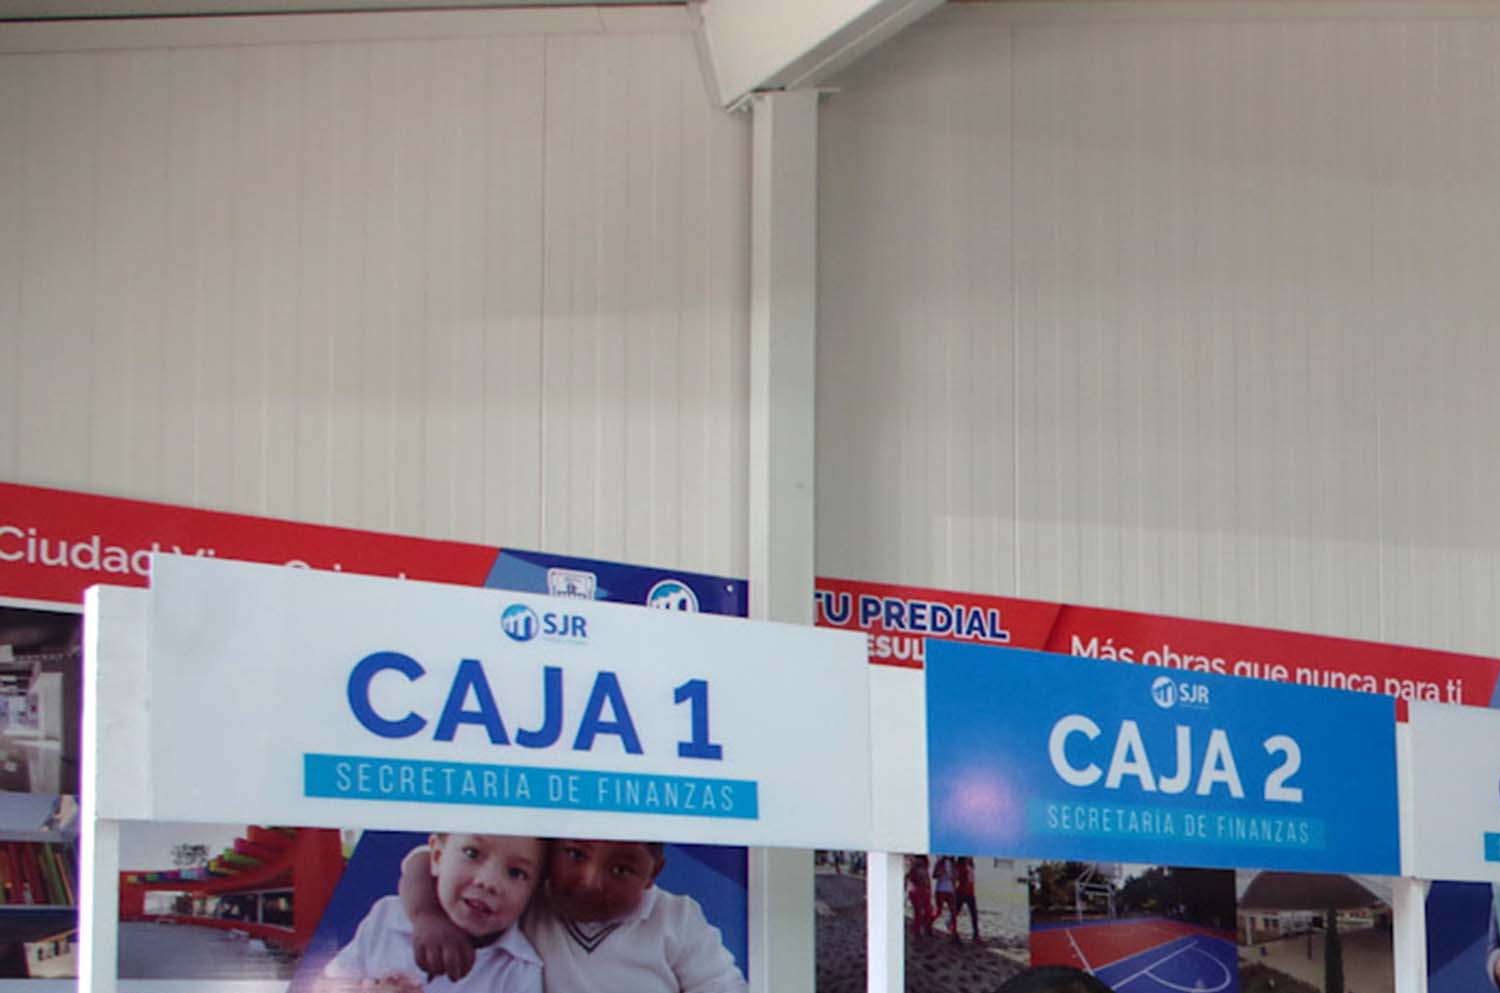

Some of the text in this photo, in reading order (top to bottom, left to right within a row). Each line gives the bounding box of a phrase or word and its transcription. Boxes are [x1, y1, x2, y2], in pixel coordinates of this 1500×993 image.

[0, 526, 159, 576] Ciudad
[542, 612, 588, 638] SJR
[814, 593, 1010, 643] U PREDIAL
[1071, 634, 1463, 704] Más obras que nunca para ti
[1179, 683, 1210, 704] SJR
[346, 651, 724, 761] CAJA 1
[1049, 714, 1303, 803] CAJA 2
[335, 761, 735, 812] SECRETARÍA DE FINANZAS
[1185, 813, 1207, 838] DE
[1217, 816, 1311, 843] FINANZAS
